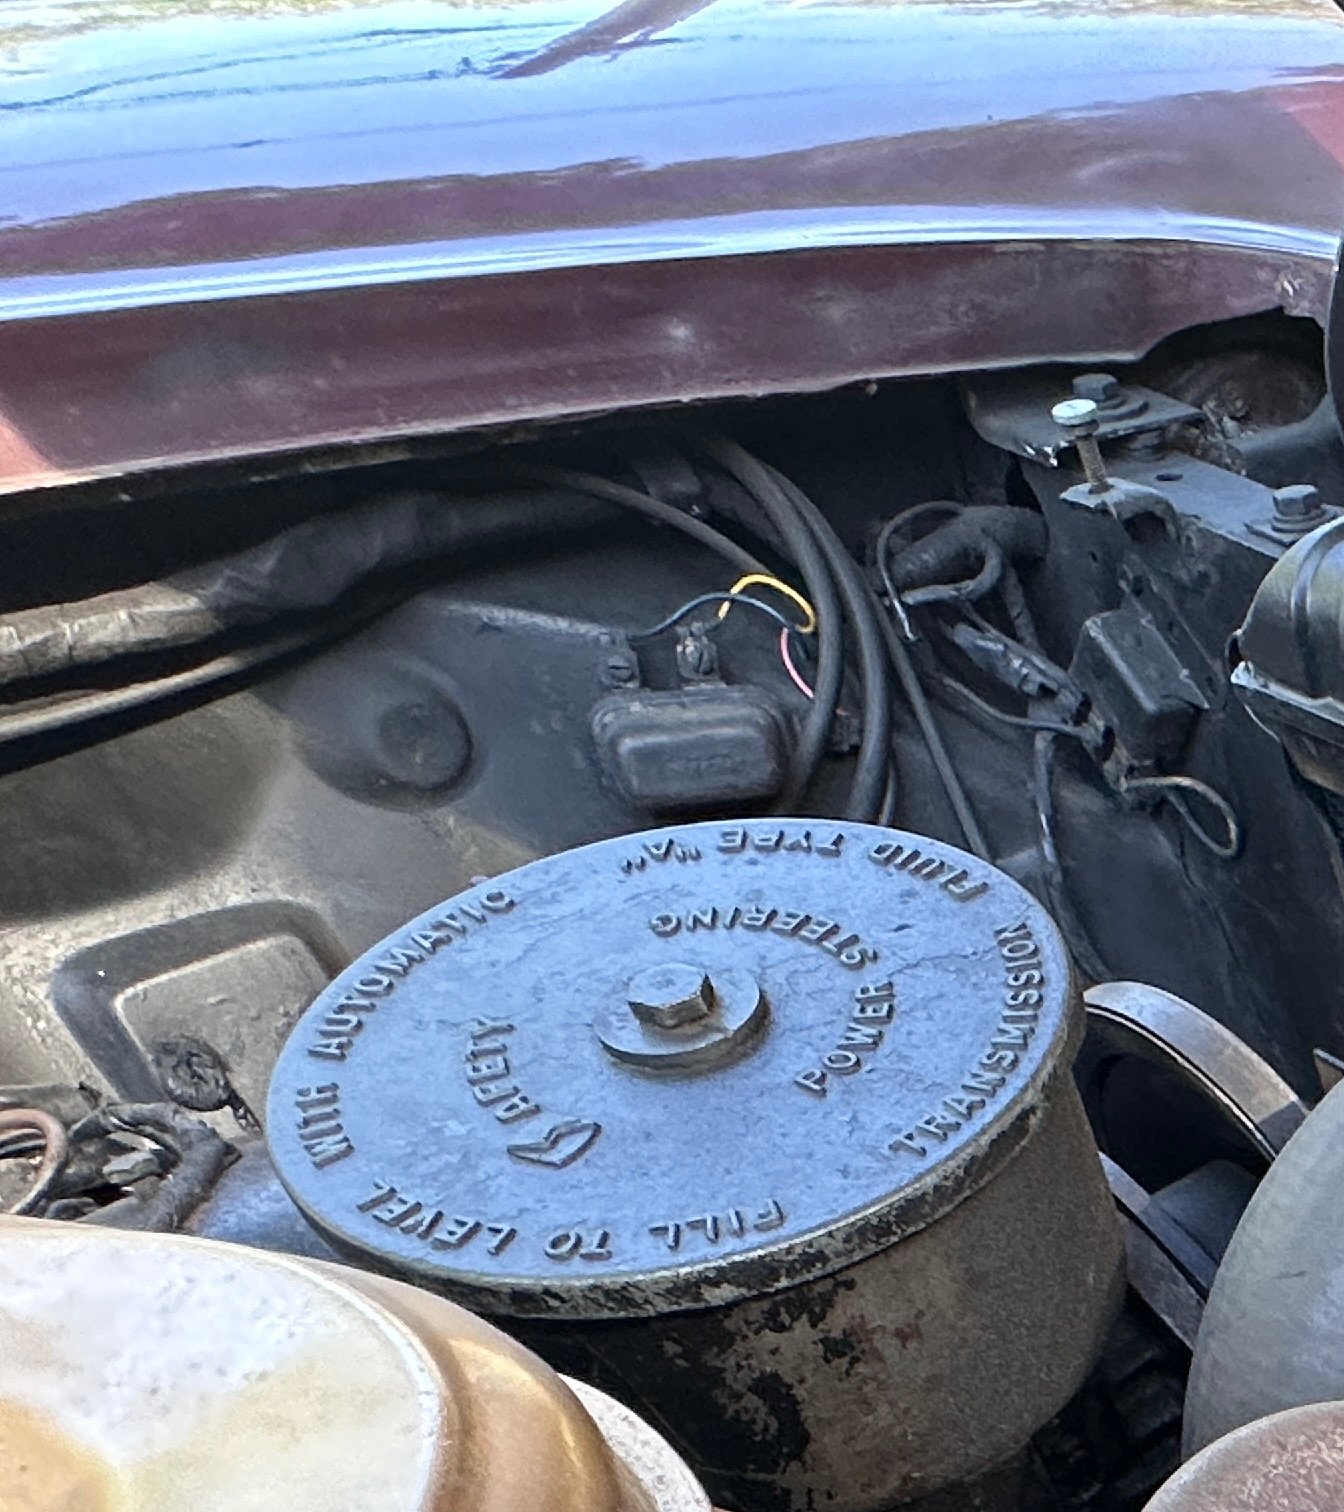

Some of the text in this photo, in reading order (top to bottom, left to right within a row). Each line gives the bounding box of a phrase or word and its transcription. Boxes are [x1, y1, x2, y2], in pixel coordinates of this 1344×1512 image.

[718, 827, 846, 856] TYPE
[868, 838, 989, 900] FLUID
[648, 905, 879, 969] STEERING
[295, 887, 517, 1169] WITH AUTOMATIC
[794, 978, 897, 1098] POWER
[888, 921, 1044, 1159] TRANSMISSION
[355, 1176, 787, 1262] FILL TO LEVEL
